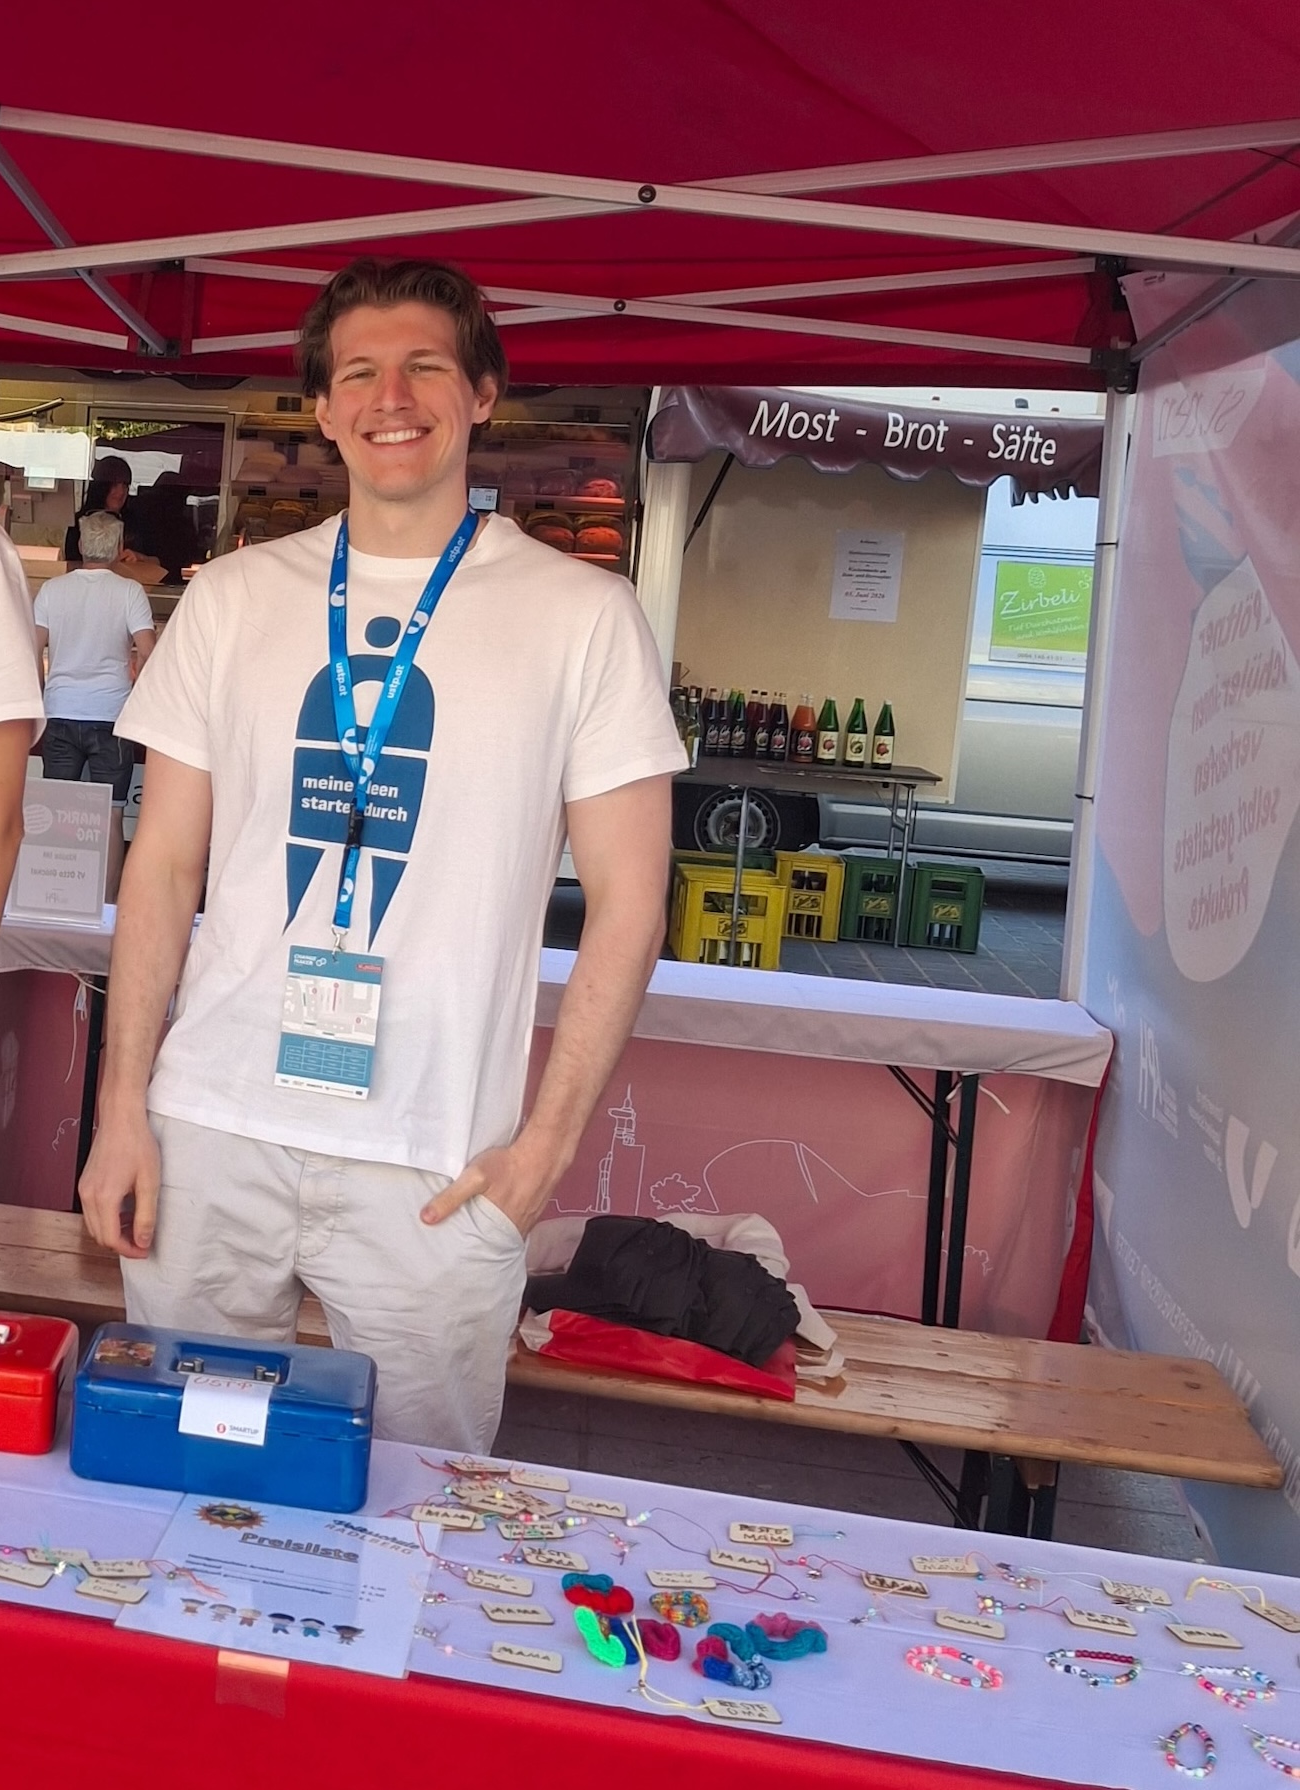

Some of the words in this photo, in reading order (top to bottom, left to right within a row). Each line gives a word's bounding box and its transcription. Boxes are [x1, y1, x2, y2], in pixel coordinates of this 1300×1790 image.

[748, 400, 840, 443] Most
[884, 412, 950, 453] Brot
[987, 422, 1058, 466] Säfte
[446, 536, 465, 563] ustp.at
[336, 661, 348, 698] ustp.at
[386, 664, 406, 700] ustp.at
[302, 775, 354, 793] meine
[300, 796, 355, 815] starte
[363, 801, 408, 823] durch
[240, 1531, 360, 1561] Preisliste
